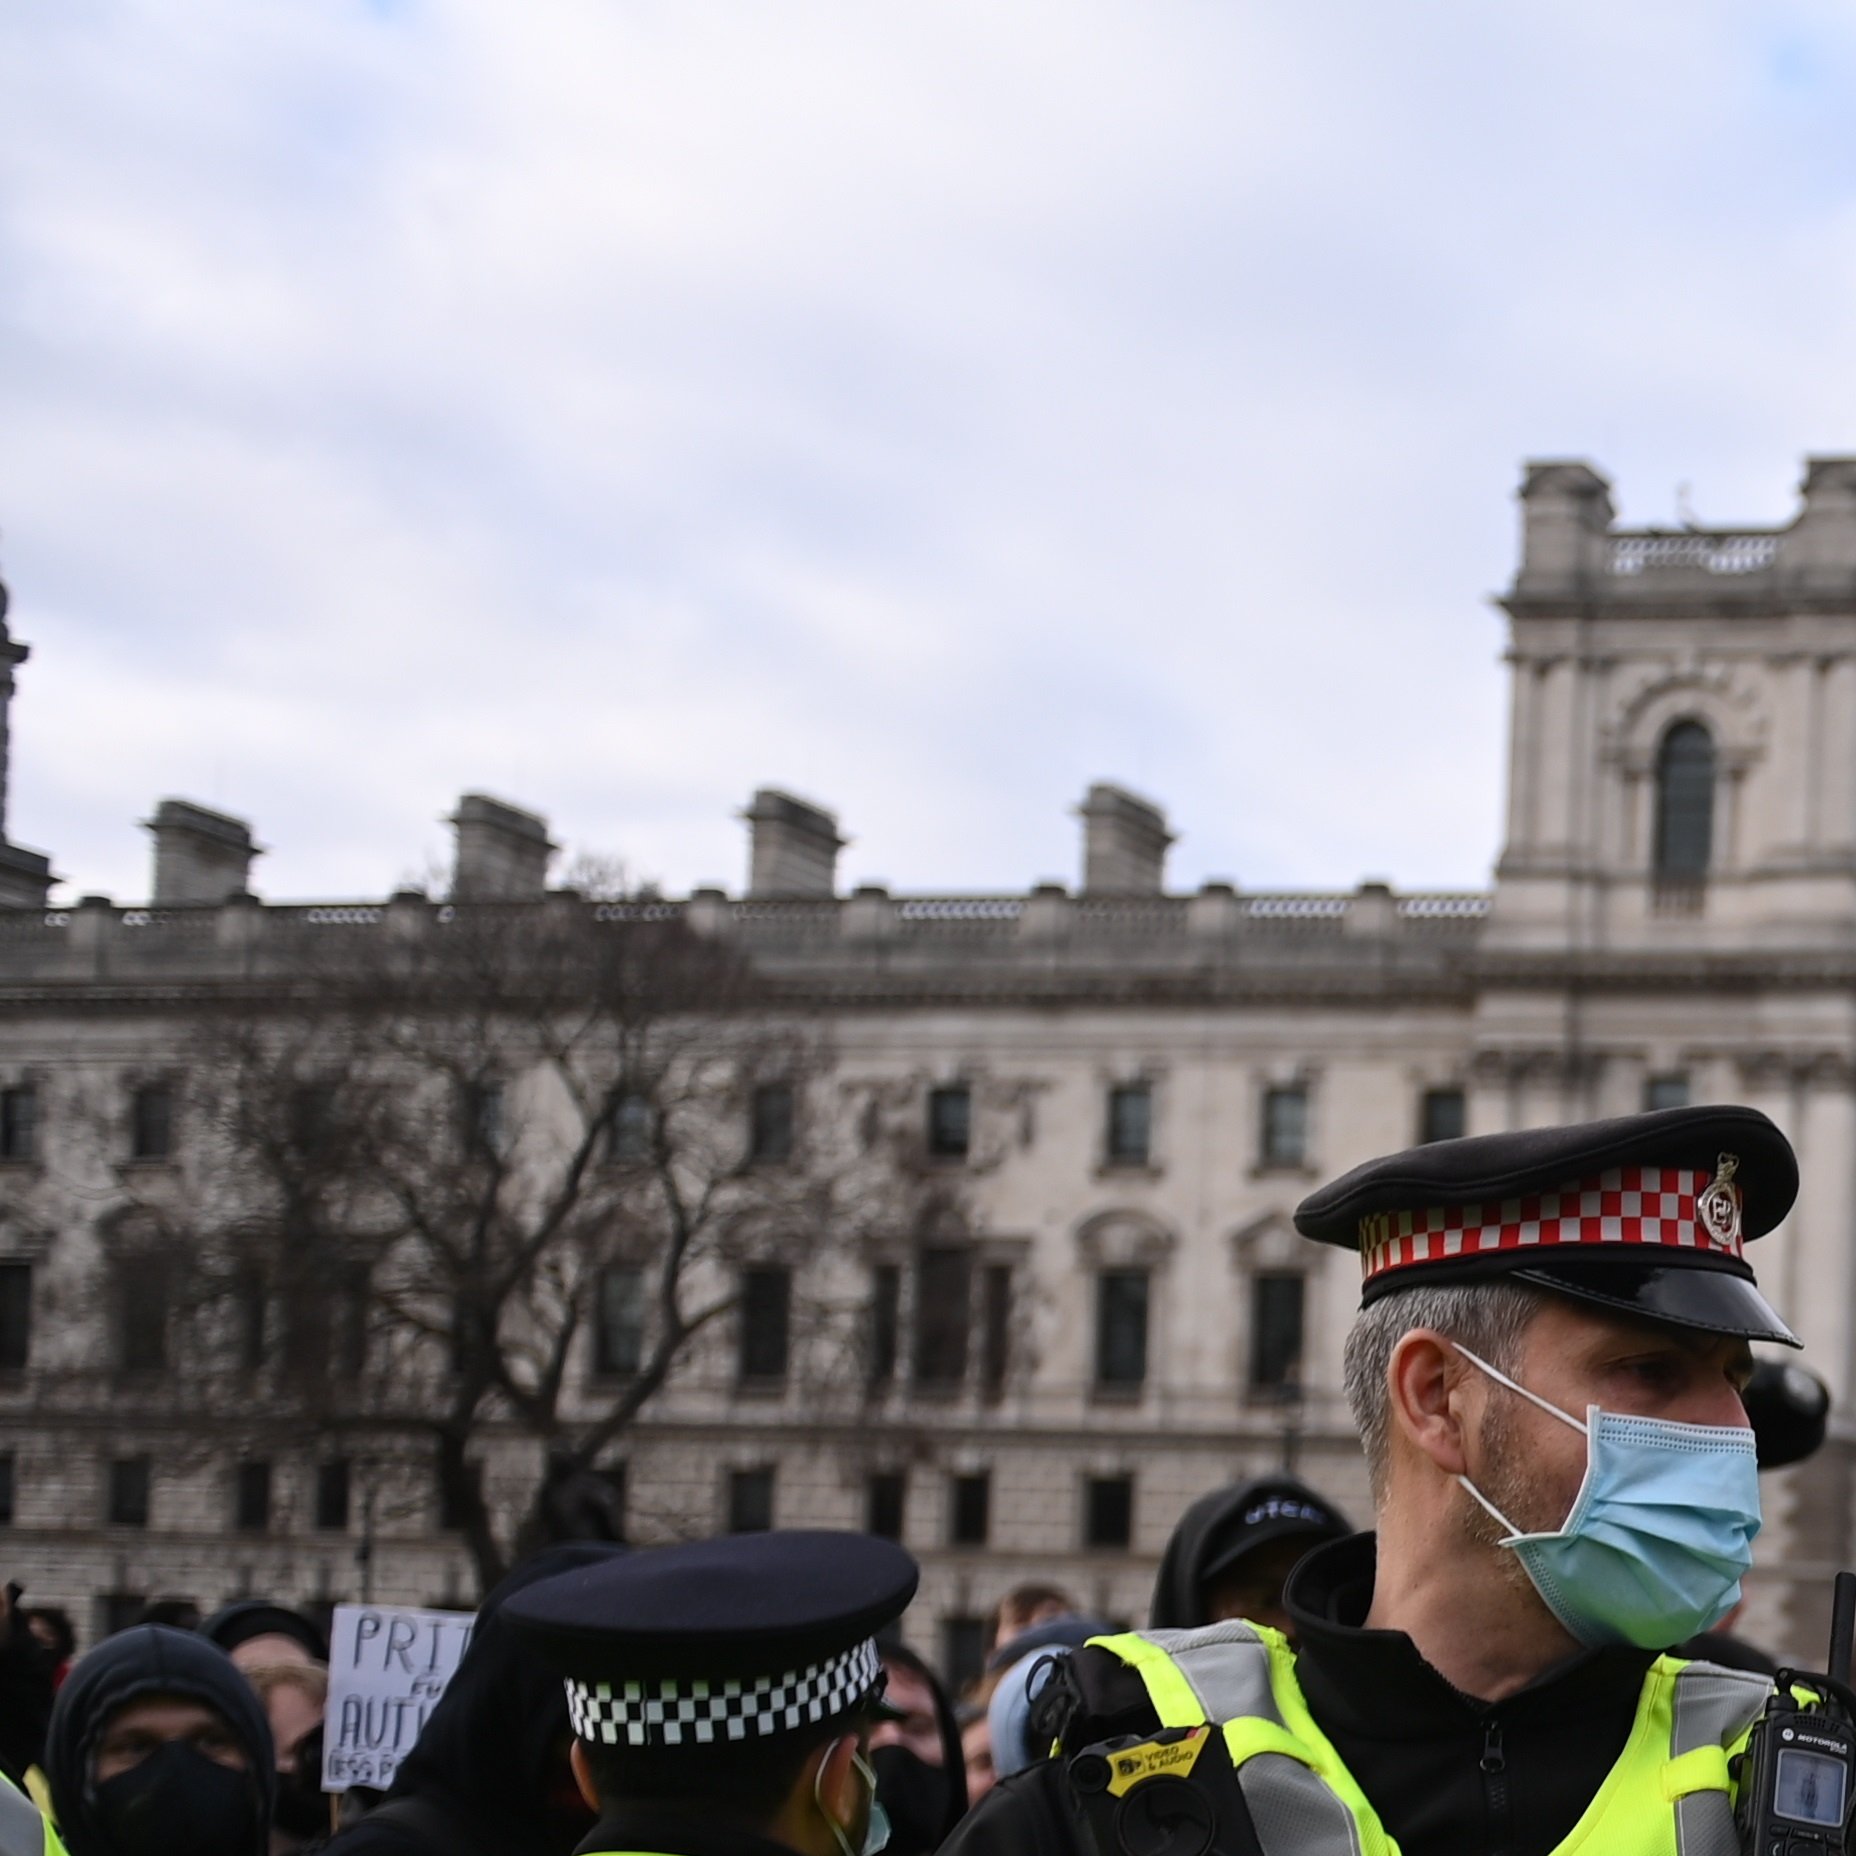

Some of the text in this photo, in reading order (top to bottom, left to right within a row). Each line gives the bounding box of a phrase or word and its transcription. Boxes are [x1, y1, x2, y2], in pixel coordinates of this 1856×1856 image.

[1797, 1733, 1848, 1750] MOTOROLA
[1145, 1745, 1180, 1762] VIDEO
[1159, 1751, 1194, 1769] AUDIO
